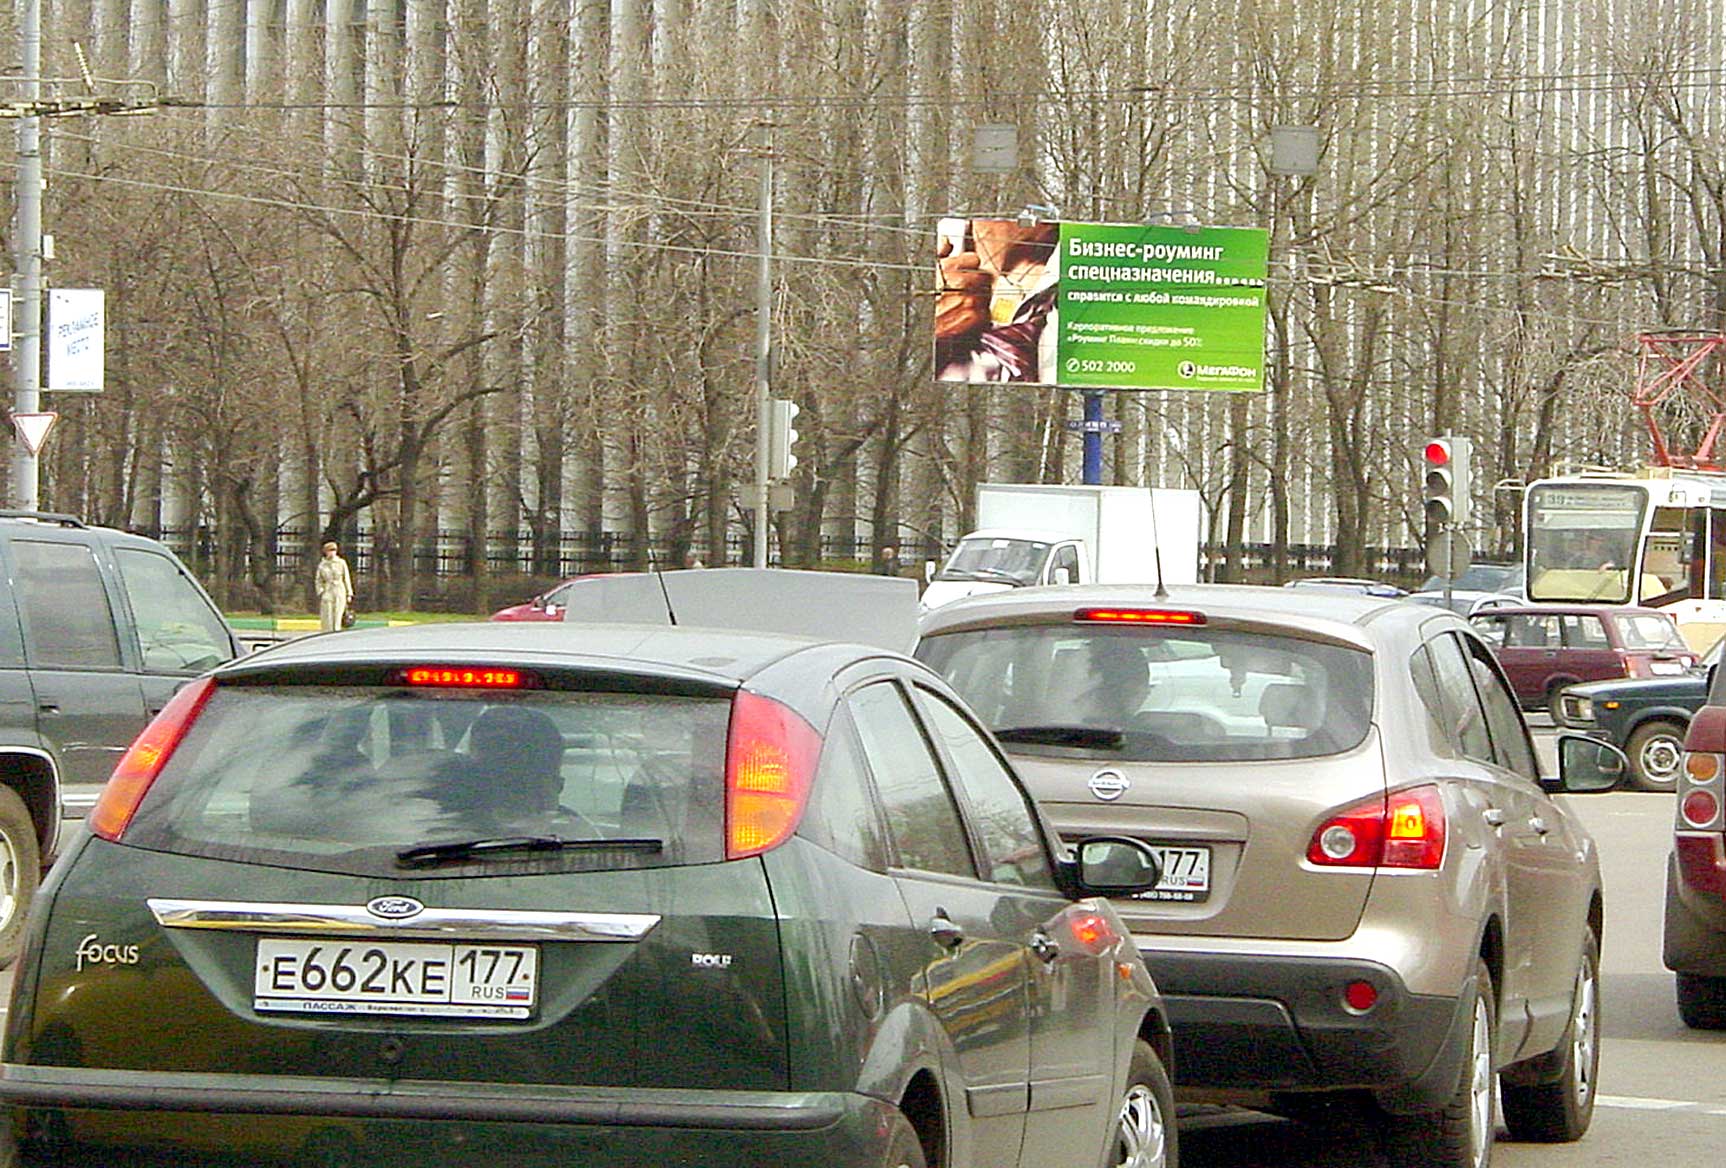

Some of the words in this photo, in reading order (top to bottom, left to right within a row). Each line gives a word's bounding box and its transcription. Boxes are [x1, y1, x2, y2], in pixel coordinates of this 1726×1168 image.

[1069, 238, 1224, 262] Бизнес-роуминг
[1067, 290, 1123, 304] справится
[1125, 293, 1132, 303] с
[1133, 291, 1170, 304] любой
[1172, 294, 1260, 309] командировкой
[1081, 359, 1104, 372] 502
[1107, 361, 1136, 374] 2000
[75, 933, 139, 972] focus
[458, 950, 525, 985] 177
[472, 986, 505, 999] RUS
[303, 1002, 357, 1011] ПАССАЖ
